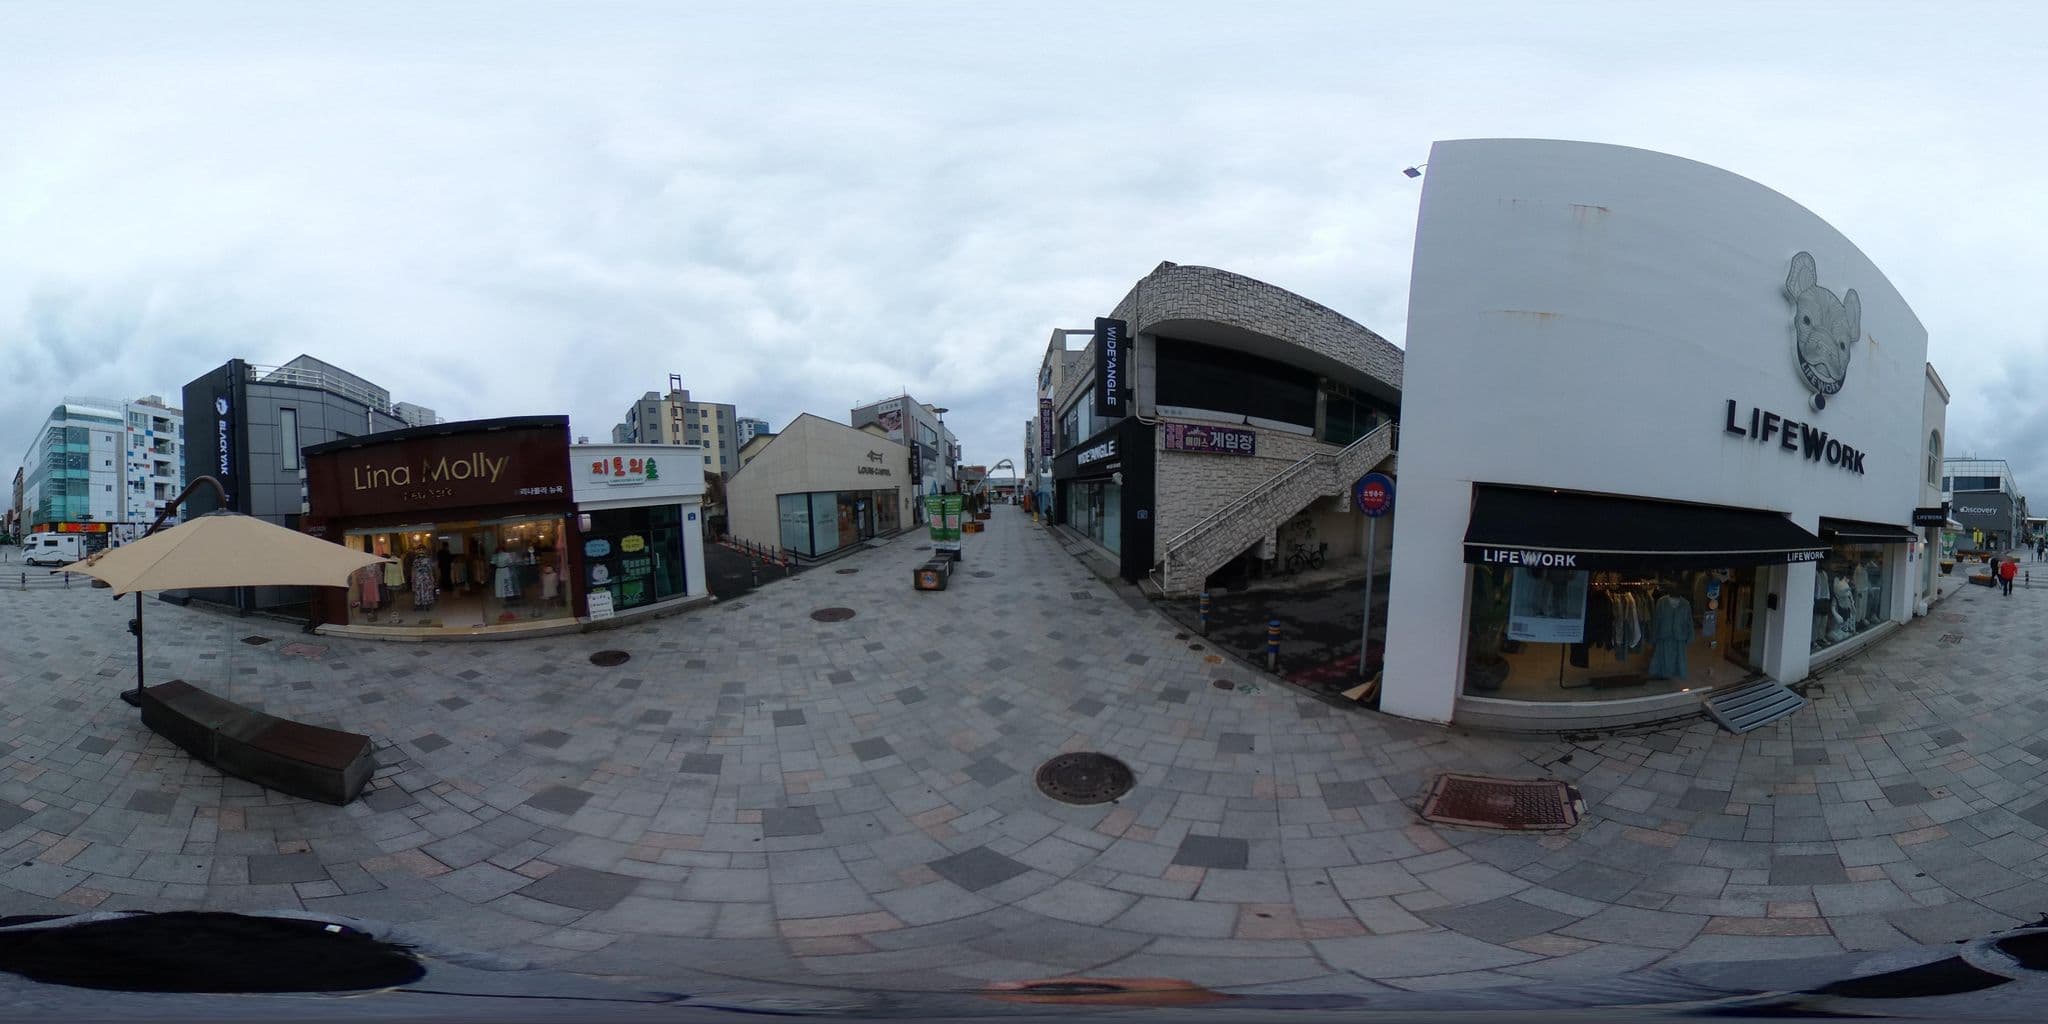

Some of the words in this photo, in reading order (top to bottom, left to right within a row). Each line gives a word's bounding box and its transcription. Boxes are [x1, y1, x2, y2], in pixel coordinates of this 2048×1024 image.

[1210, 431, 1254, 450] 게임장
[1726, 398, 1865, 475] LIFEWORK
[353, 464, 411, 490] Lina
[422, 452, 509, 483] Molly
[1483, 548, 1576, 567] LIFEWORK
[1787, 550, 1825, 562] LIFEWORK
